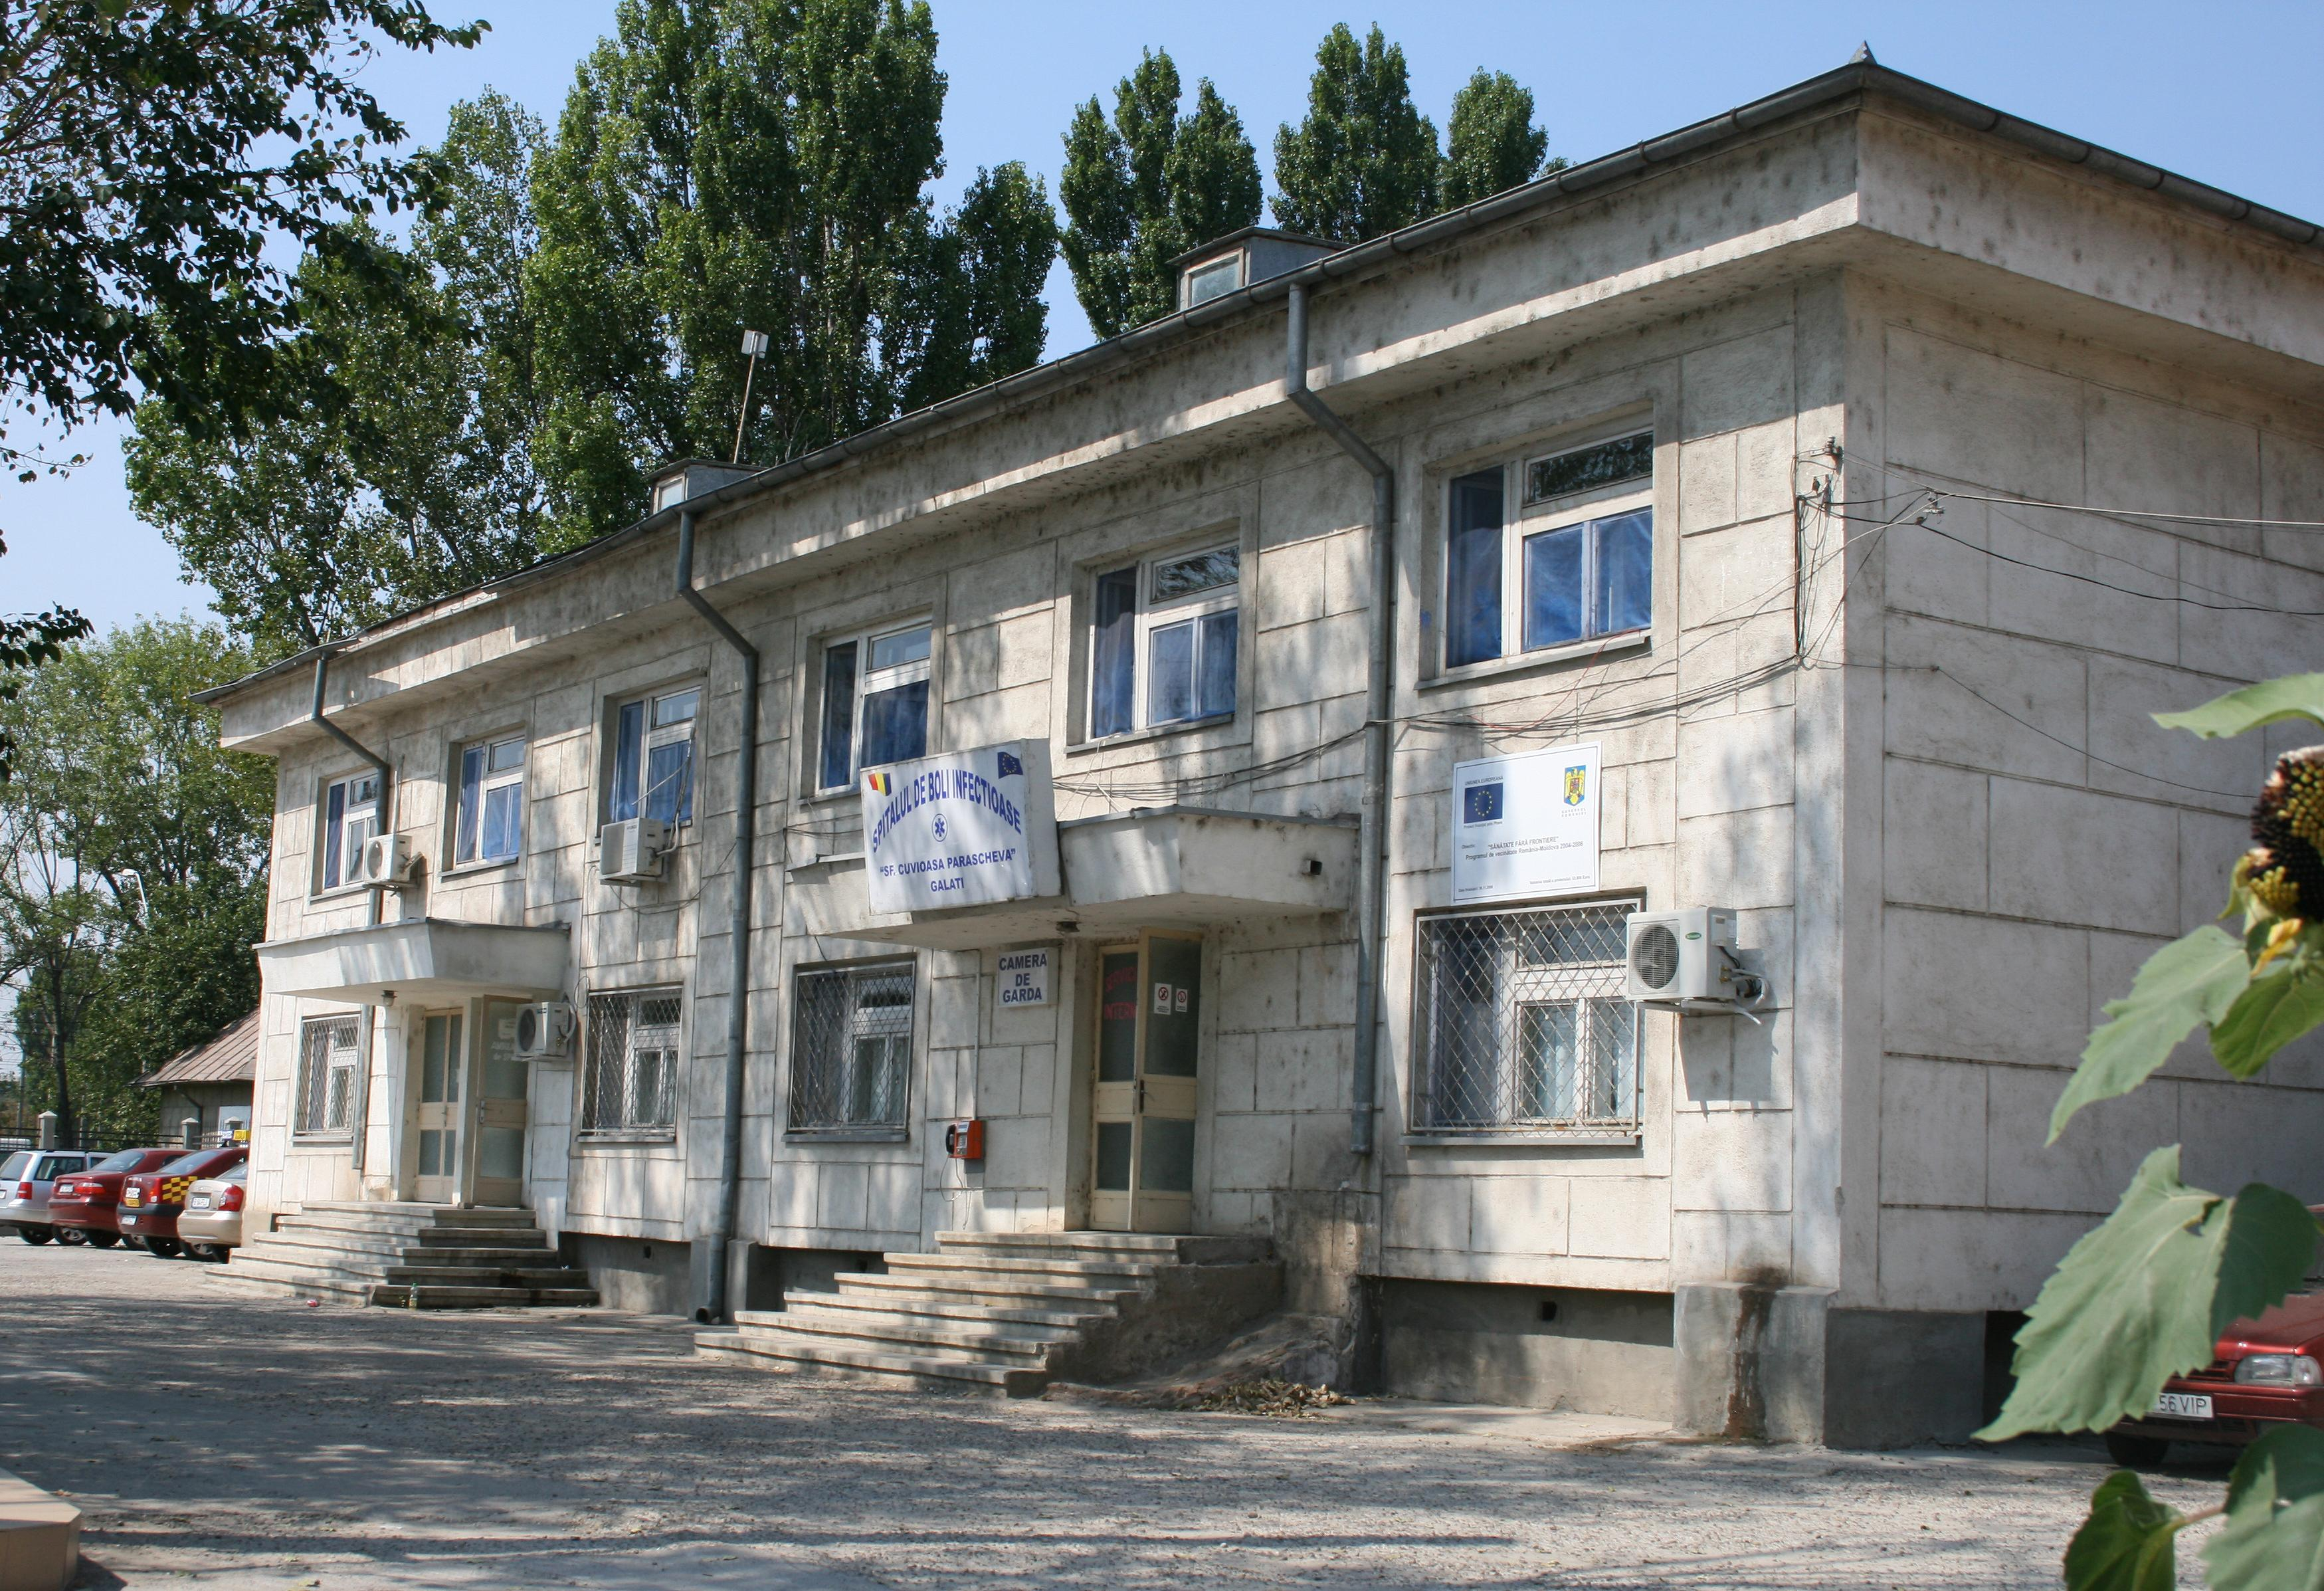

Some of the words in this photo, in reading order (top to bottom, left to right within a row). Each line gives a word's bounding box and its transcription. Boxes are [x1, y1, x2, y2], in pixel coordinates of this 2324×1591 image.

[873, 786, 912, 853] SPITALUL
[914, 775, 926, 809] DE
[928, 770, 949, 801] BOLI
[952, 770, 1022, 835] INFECTIOASE
[898, 859, 944, 875] CUVIOASA
[931, 877, 964, 892] GALATI
[999, 953, 1047, 971] CAMERA
[1015, 973, 1030, 987] DE
[1003, 987, 1042, 1003] GARDA
[2179, 1396, 2206, 1414] VIP
